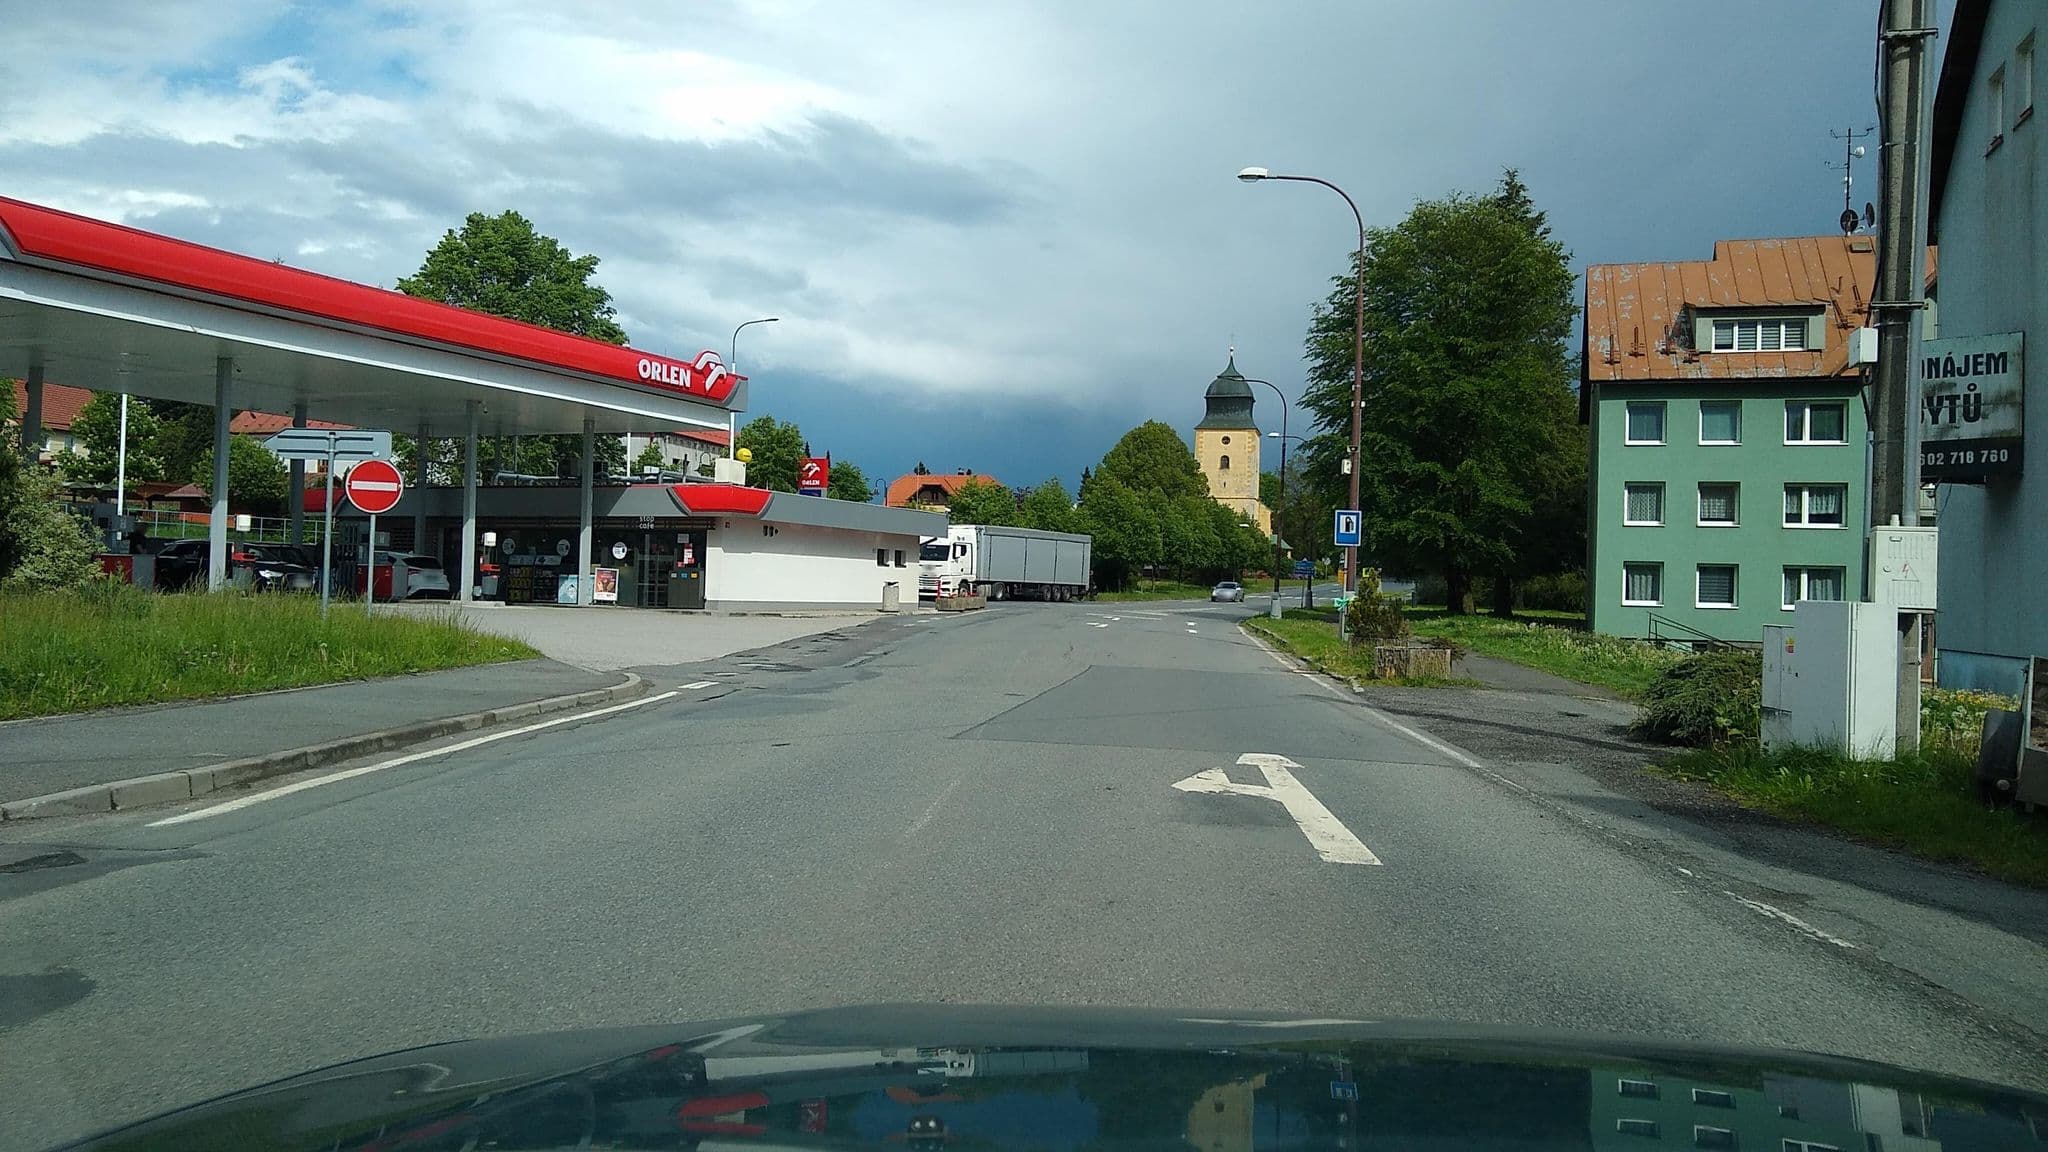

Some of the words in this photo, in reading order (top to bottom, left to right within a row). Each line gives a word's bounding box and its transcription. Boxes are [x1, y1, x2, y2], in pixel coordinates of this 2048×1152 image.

[638, 359, 691, 387] ORLEN
[1921, 352, 2008, 380] NÁJEM
[1921, 383, 1982, 425] YTŮ
[1950, 451, 1975, 465] 718
